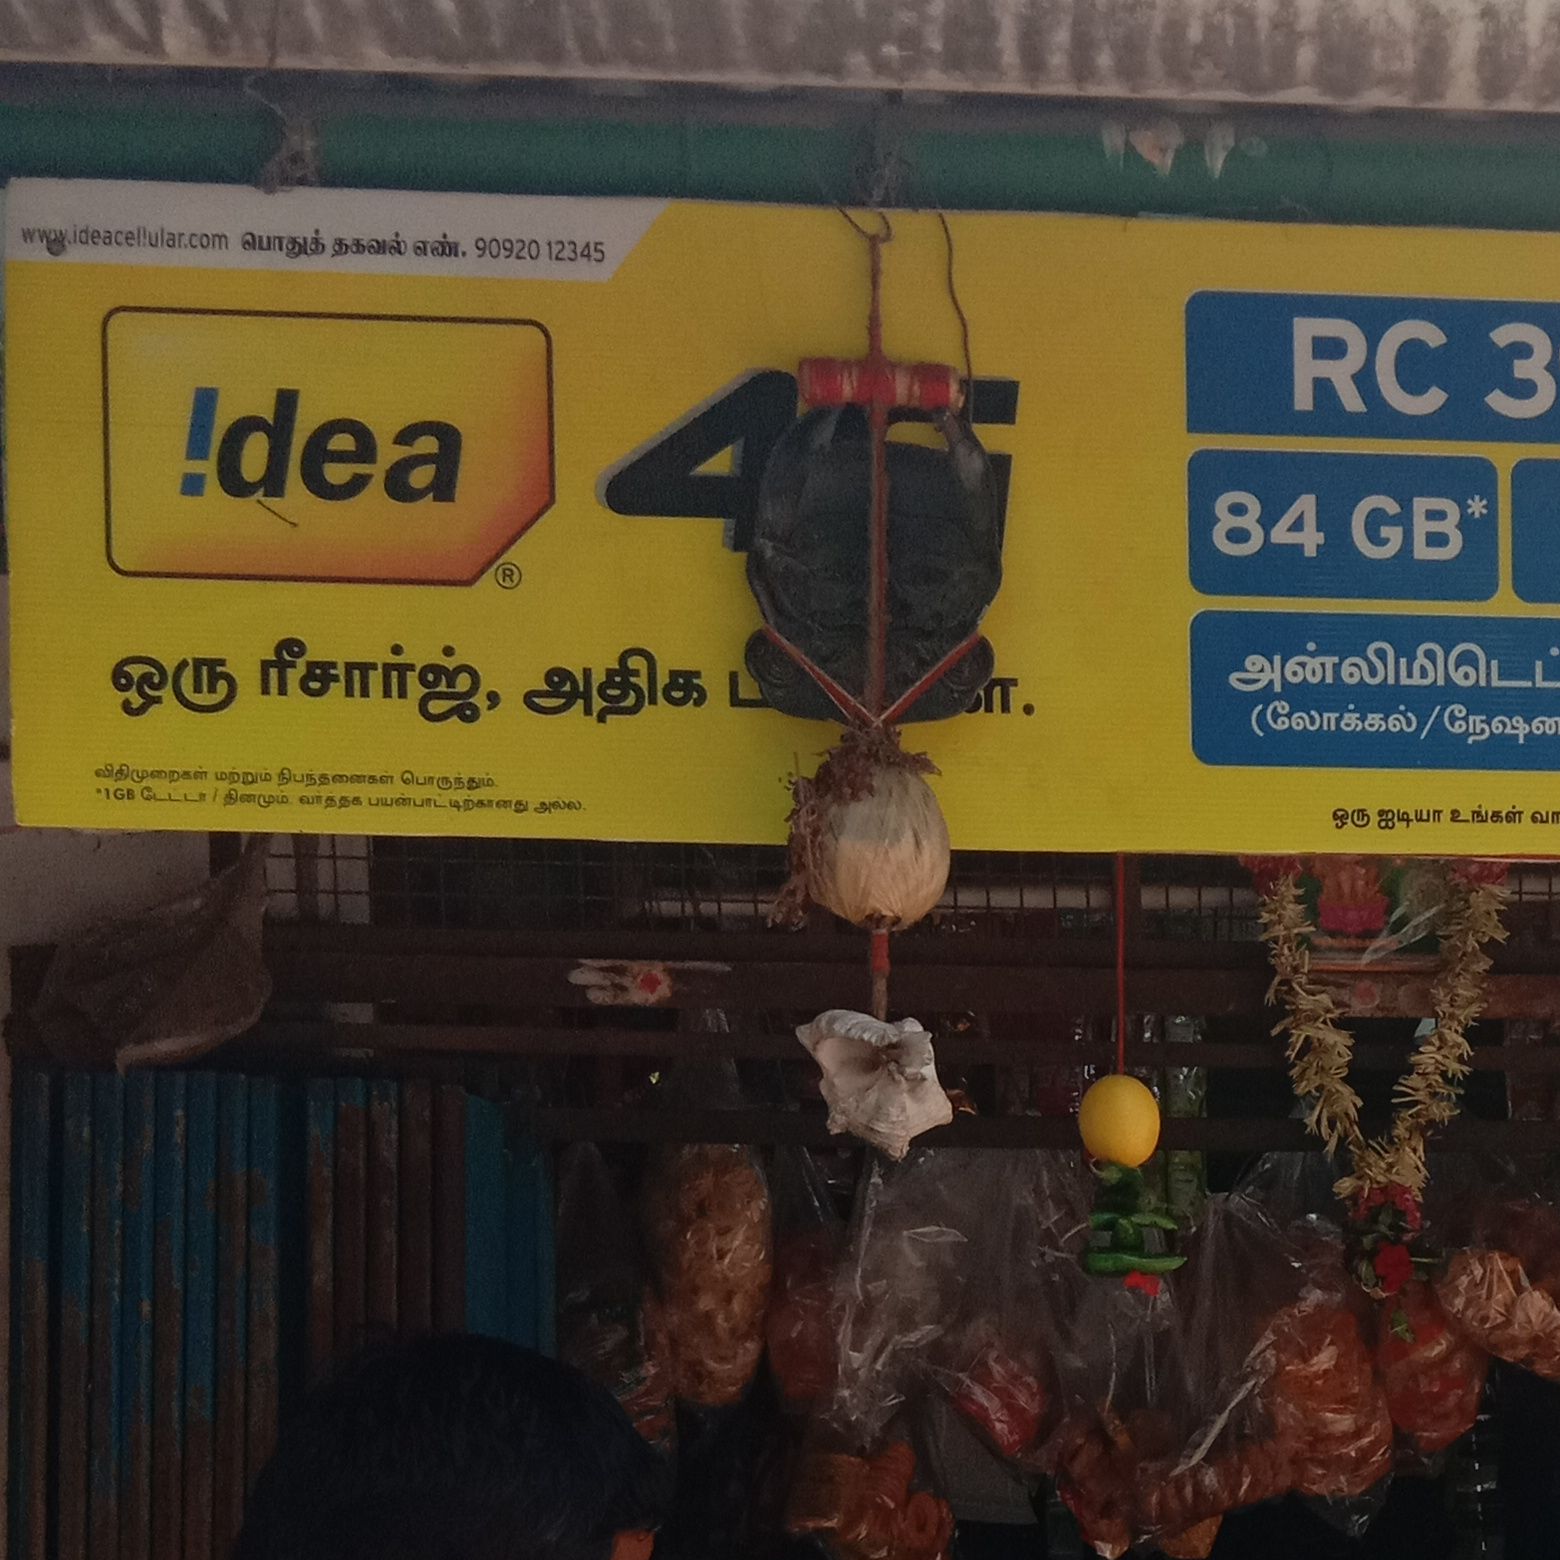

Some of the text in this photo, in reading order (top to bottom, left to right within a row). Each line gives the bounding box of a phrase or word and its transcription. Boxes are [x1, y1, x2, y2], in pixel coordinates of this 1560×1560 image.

[331, 231, 408, 258] தகவல்
[474, 237, 540, 260] 90920
[546, 239, 606, 263] 12345
[1293, 316, 1449, 416] RC
[1211, 490, 1325, 557] 84
[111, 654, 239, 717] ஒரு
[259, 636, 501, 724] ரீசார்ஜ்,
[522, 646, 709, 724] அதிக
[1332, 806, 1371, 829] ஒரு
[1377, 805, 1445, 830] ஐடியா
[1449, 804, 1525, 826] உங்கள்
